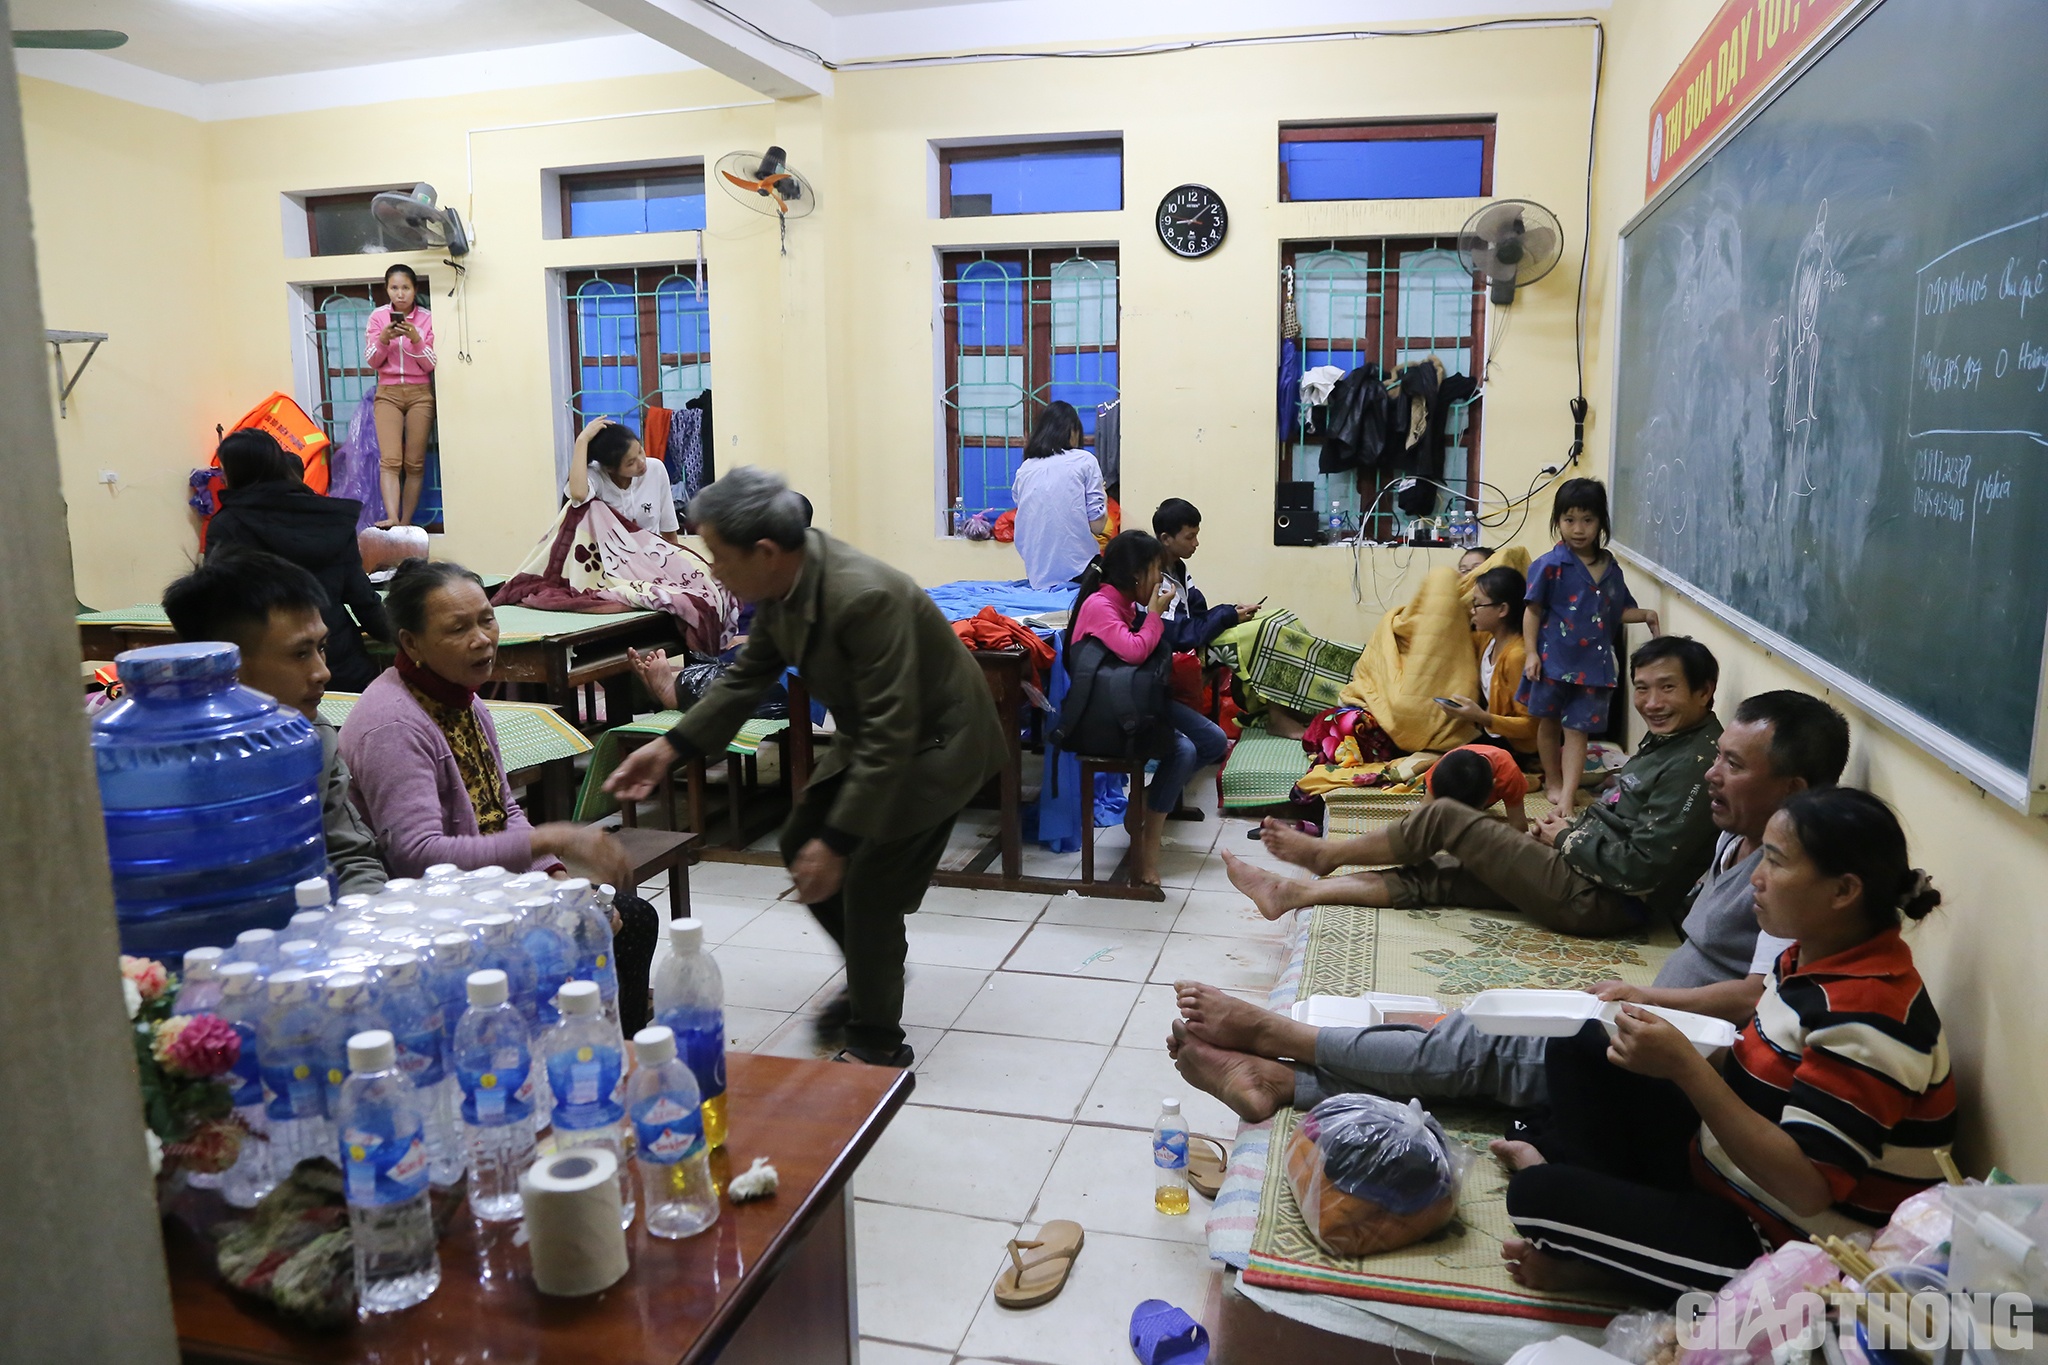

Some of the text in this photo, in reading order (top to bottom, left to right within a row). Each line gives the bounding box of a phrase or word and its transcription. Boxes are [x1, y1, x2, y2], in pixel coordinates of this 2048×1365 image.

[1664, 96, 1682, 163] THI
[1684, 59, 1712, 141] ĐUA
[1716, 7, 1752, 107] DẠY
[1177, 195, 1185, 205] 11
[1188, 191, 1198, 202] 12
[1203, 195, 1207, 205] 1
[1168, 203, 1177, 213] 10
[1210, 203, 1218, 214] 2
[1164, 215, 1172, 226] 9
[1213, 216, 1220, 227] 3
[1167, 227, 1174, 238] 8
[1209, 228, 1216, 239] 4
[1176, 236, 1183, 247] 7
[1187, 240, 1195, 250] 6
[1200, 237, 1208, 247] 5
